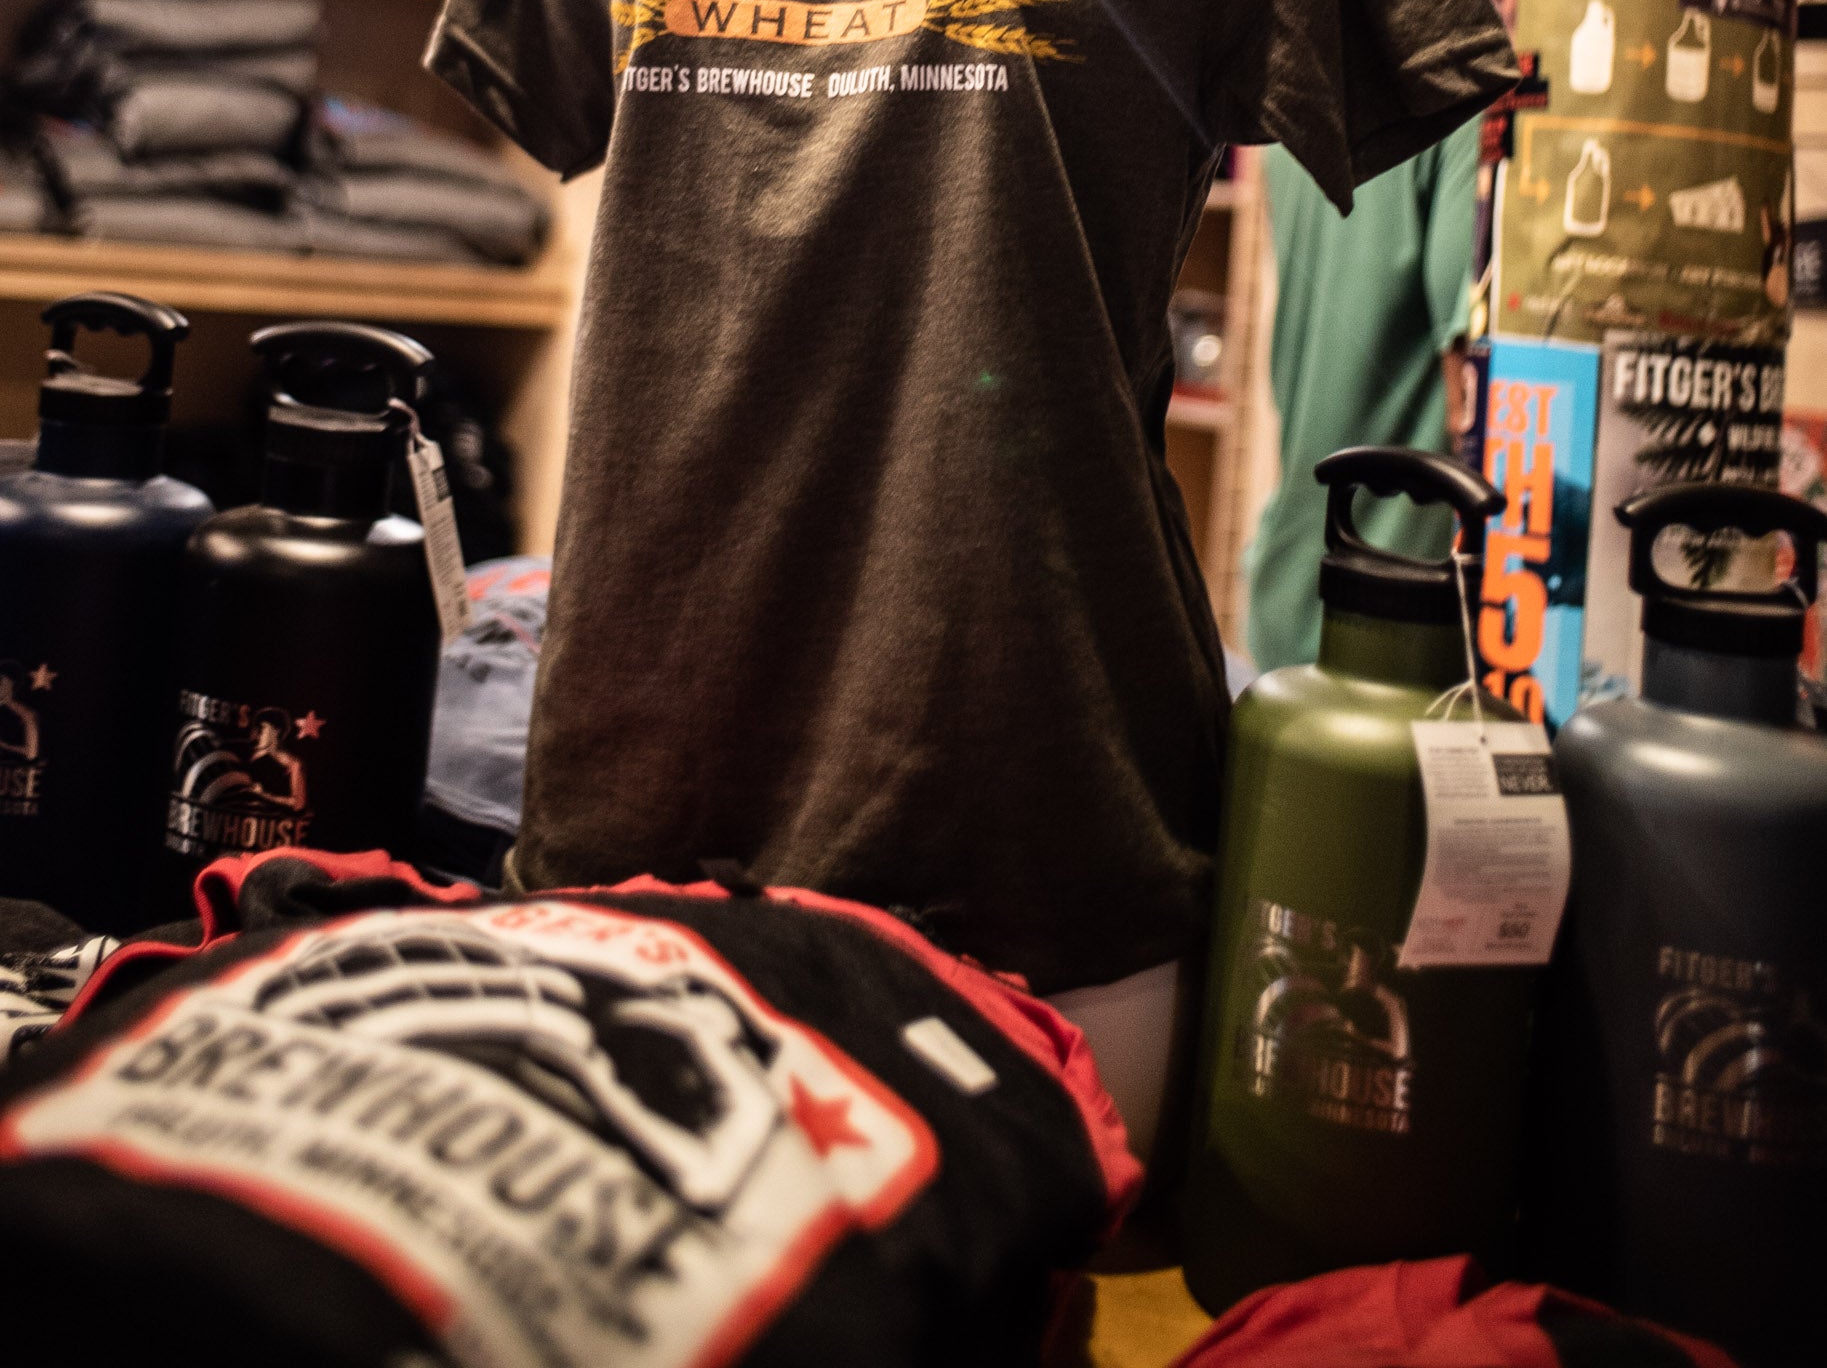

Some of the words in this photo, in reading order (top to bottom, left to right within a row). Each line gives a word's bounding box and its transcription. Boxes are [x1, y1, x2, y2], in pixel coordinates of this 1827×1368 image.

[697, 66, 814, 99] BREWHOUSE
[901, 63, 1009, 93] MINNESOTA
[1613, 351, 1757, 413] FITGER'S
[113, 1012, 685, 1294] BREWHOUSE
